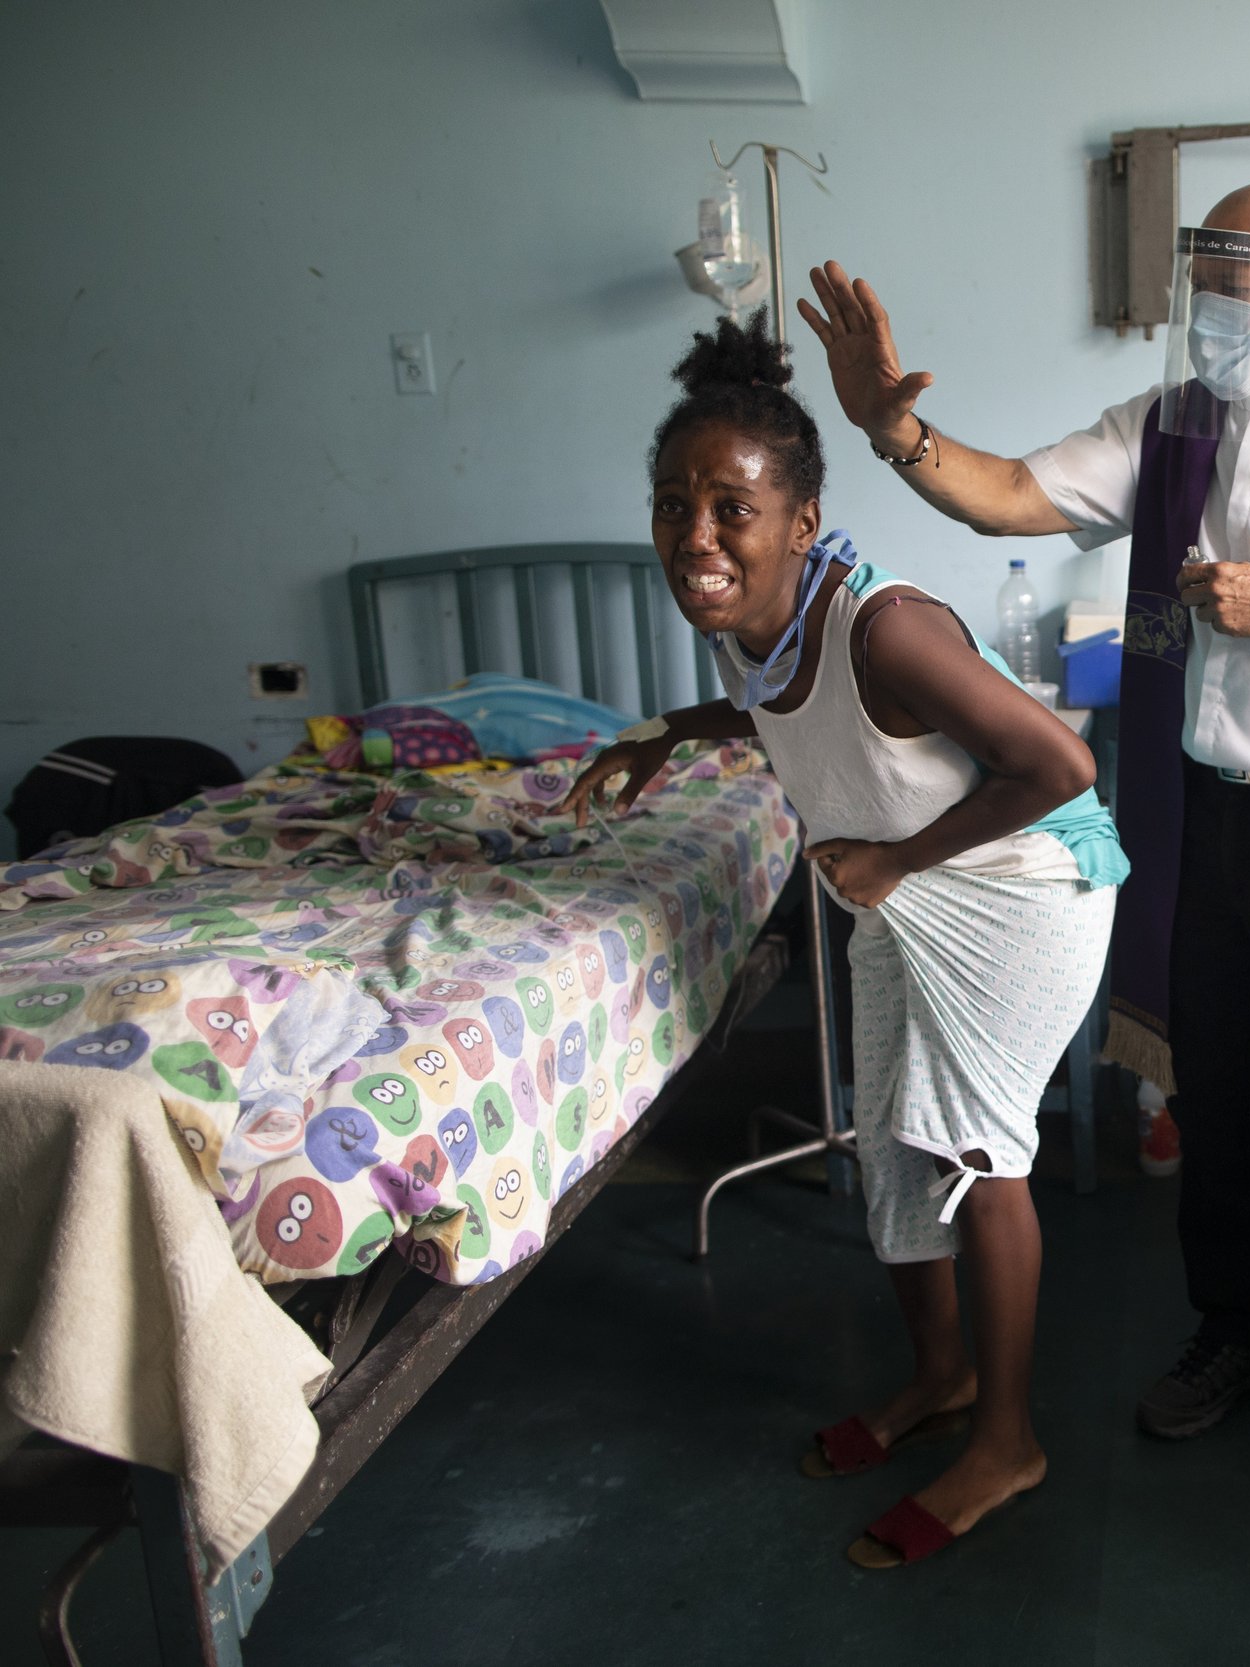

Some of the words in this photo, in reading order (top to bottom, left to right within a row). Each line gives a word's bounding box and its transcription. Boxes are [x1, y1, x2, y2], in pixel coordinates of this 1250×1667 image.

[1207, 240, 1221, 249] de
[328, 1117, 369, 1152] &
[482, 1098, 506, 1138] A
